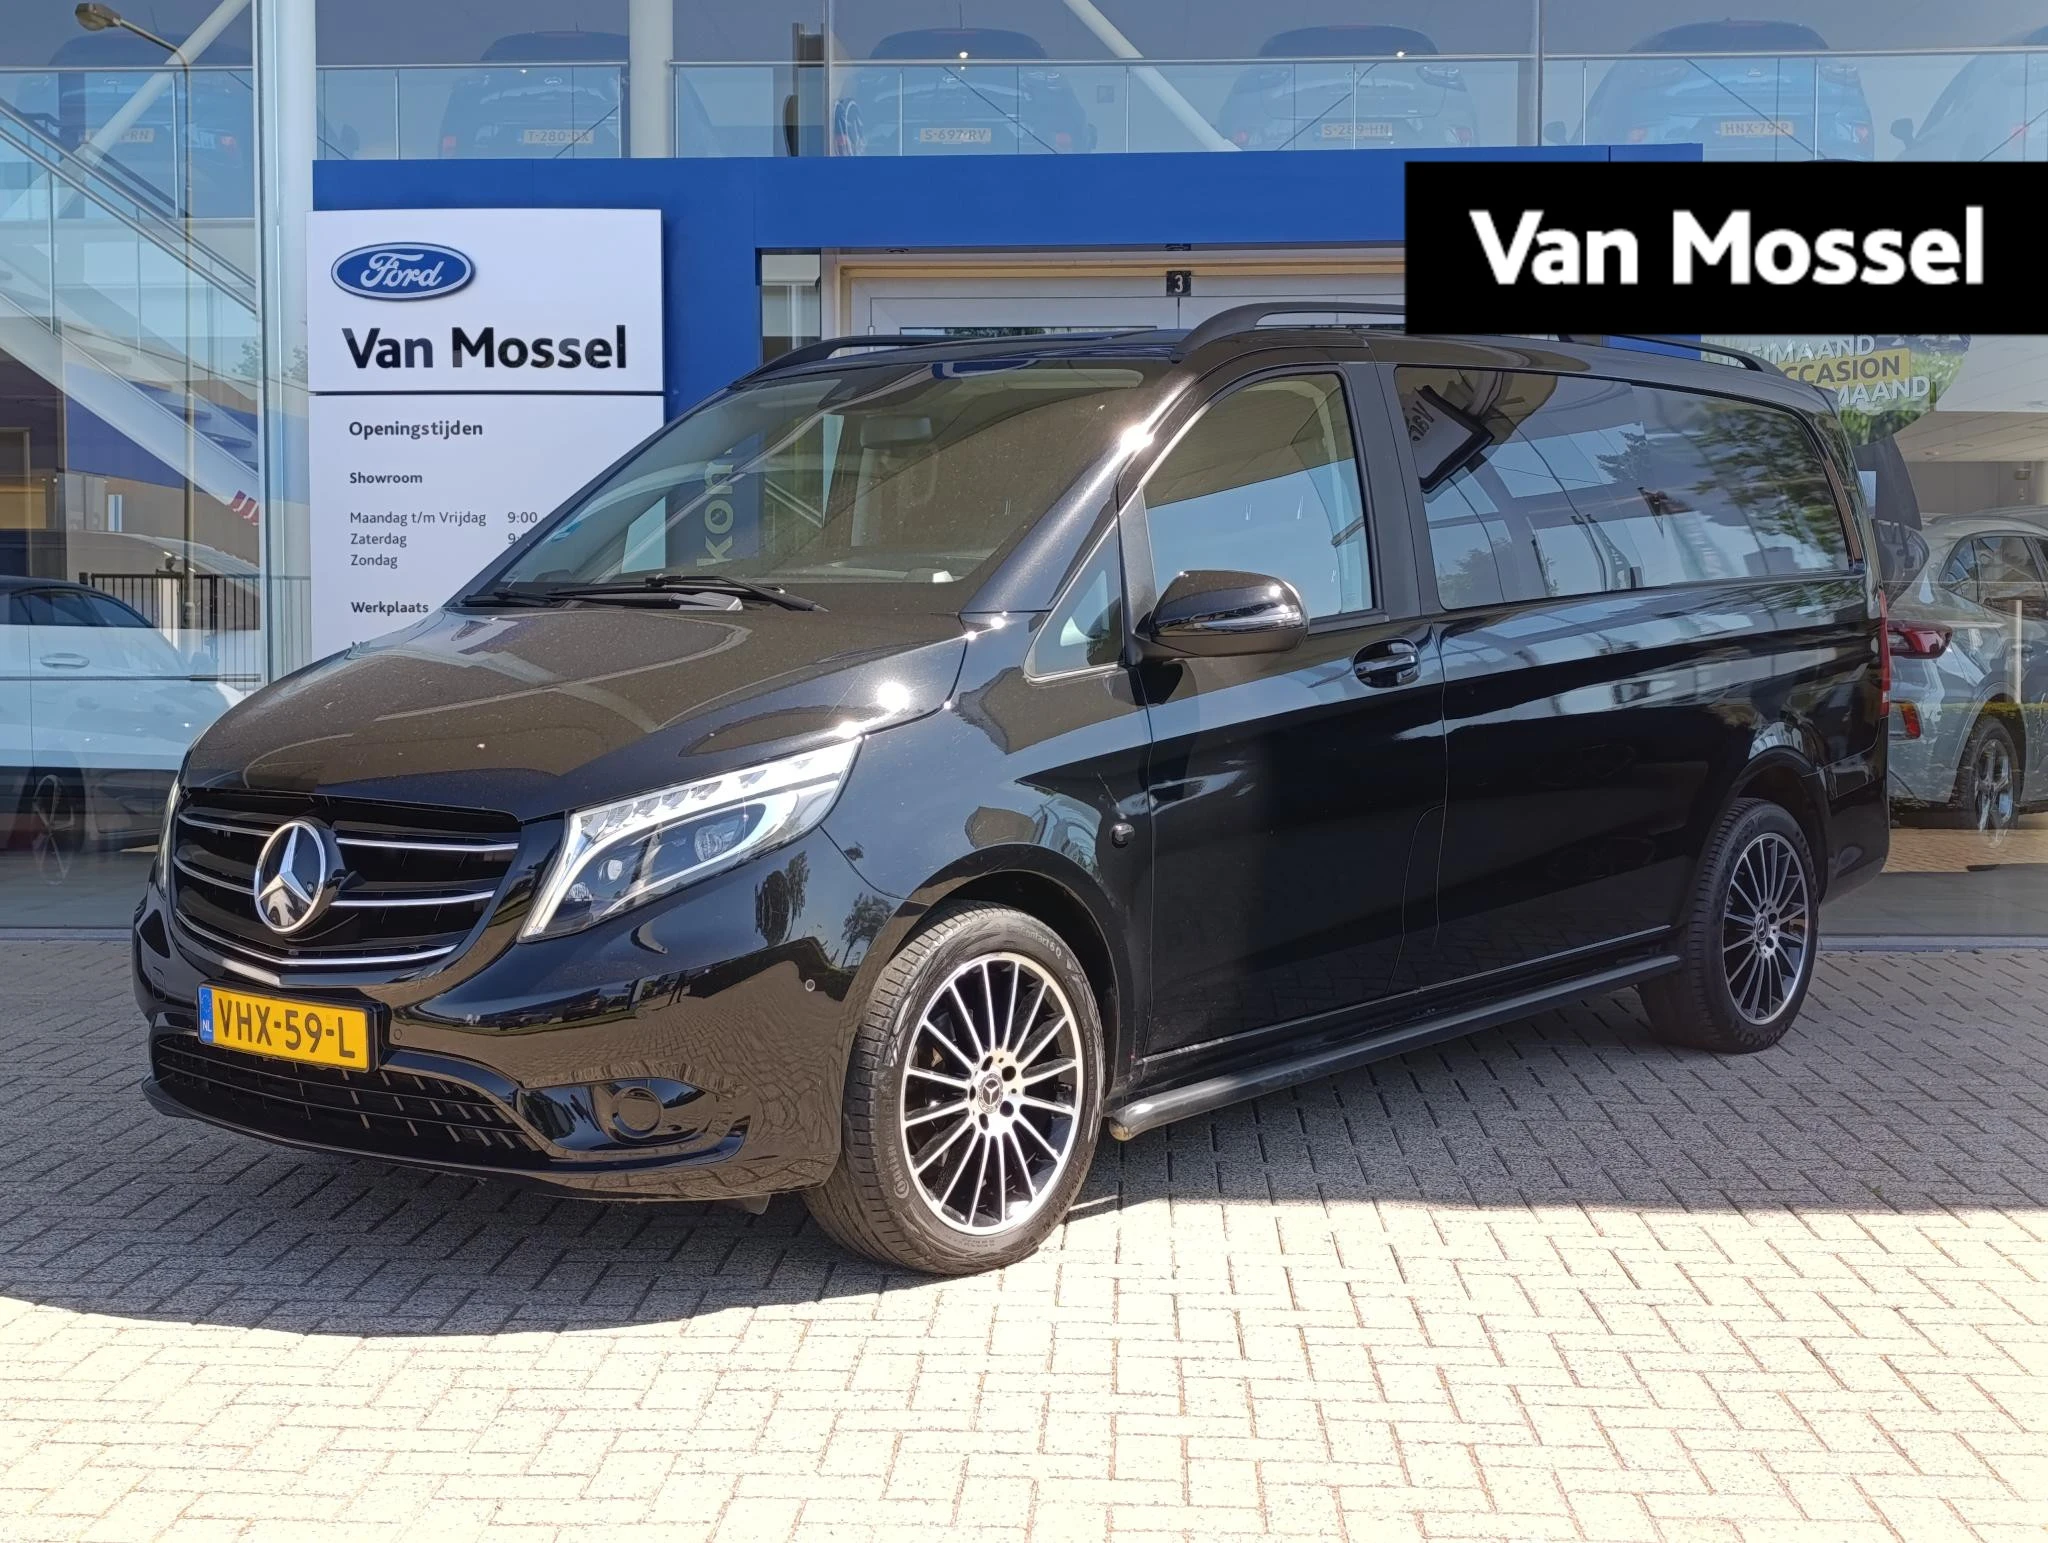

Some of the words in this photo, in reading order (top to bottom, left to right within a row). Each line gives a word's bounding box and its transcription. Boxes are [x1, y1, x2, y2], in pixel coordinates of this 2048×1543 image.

[360, 252, 445, 287] Ford
[1174, 274, 1184, 293] 3
[341, 327, 434, 369] Van
[451, 324, 627, 369] Mossel
[349, 420, 484, 441] Openingstijden
[349, 472, 424, 484] Showroom
[350, 511, 408, 527] Maandag
[411, 511, 436, 524] t/m
[439, 511, 487, 527] Vrijdag
[507, 511, 539, 524] 9:00
[350, 532, 408, 548] Zaterdag
[350, 554, 399, 570] Zondag
[351, 601, 430, 616] Werkplaats
[202, 1020, 213, 1033] NL
[218, 998, 356, 1059] VHX-59-L
